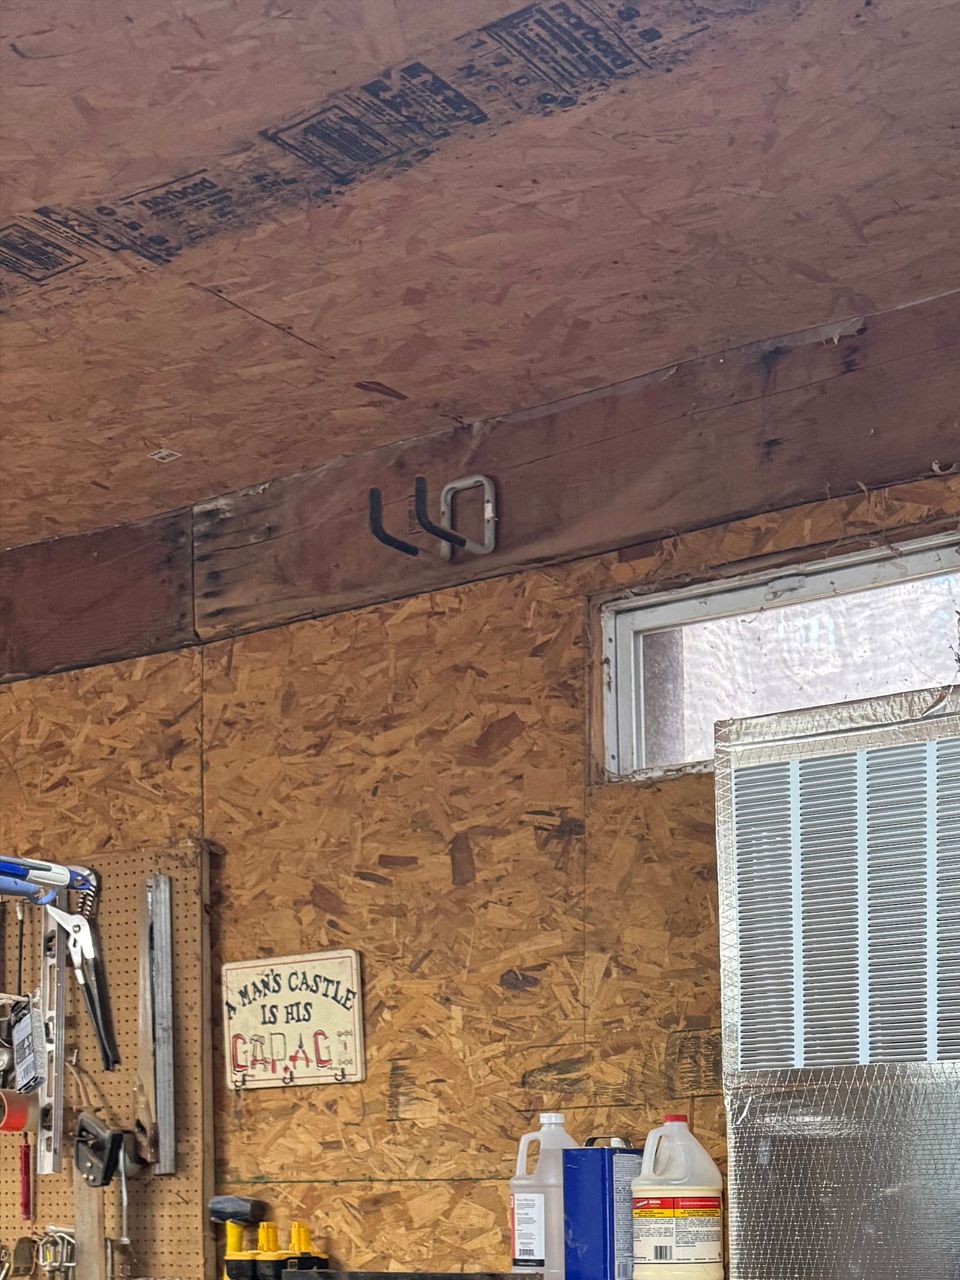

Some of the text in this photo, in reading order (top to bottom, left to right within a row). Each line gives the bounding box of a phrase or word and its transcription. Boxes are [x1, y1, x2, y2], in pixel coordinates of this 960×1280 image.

[225, 969, 357, 1020] A MAN'S CASTLE
[261, 1001, 313, 1025] IS HIS
[232, 1029, 353, 1073] GARAGE
